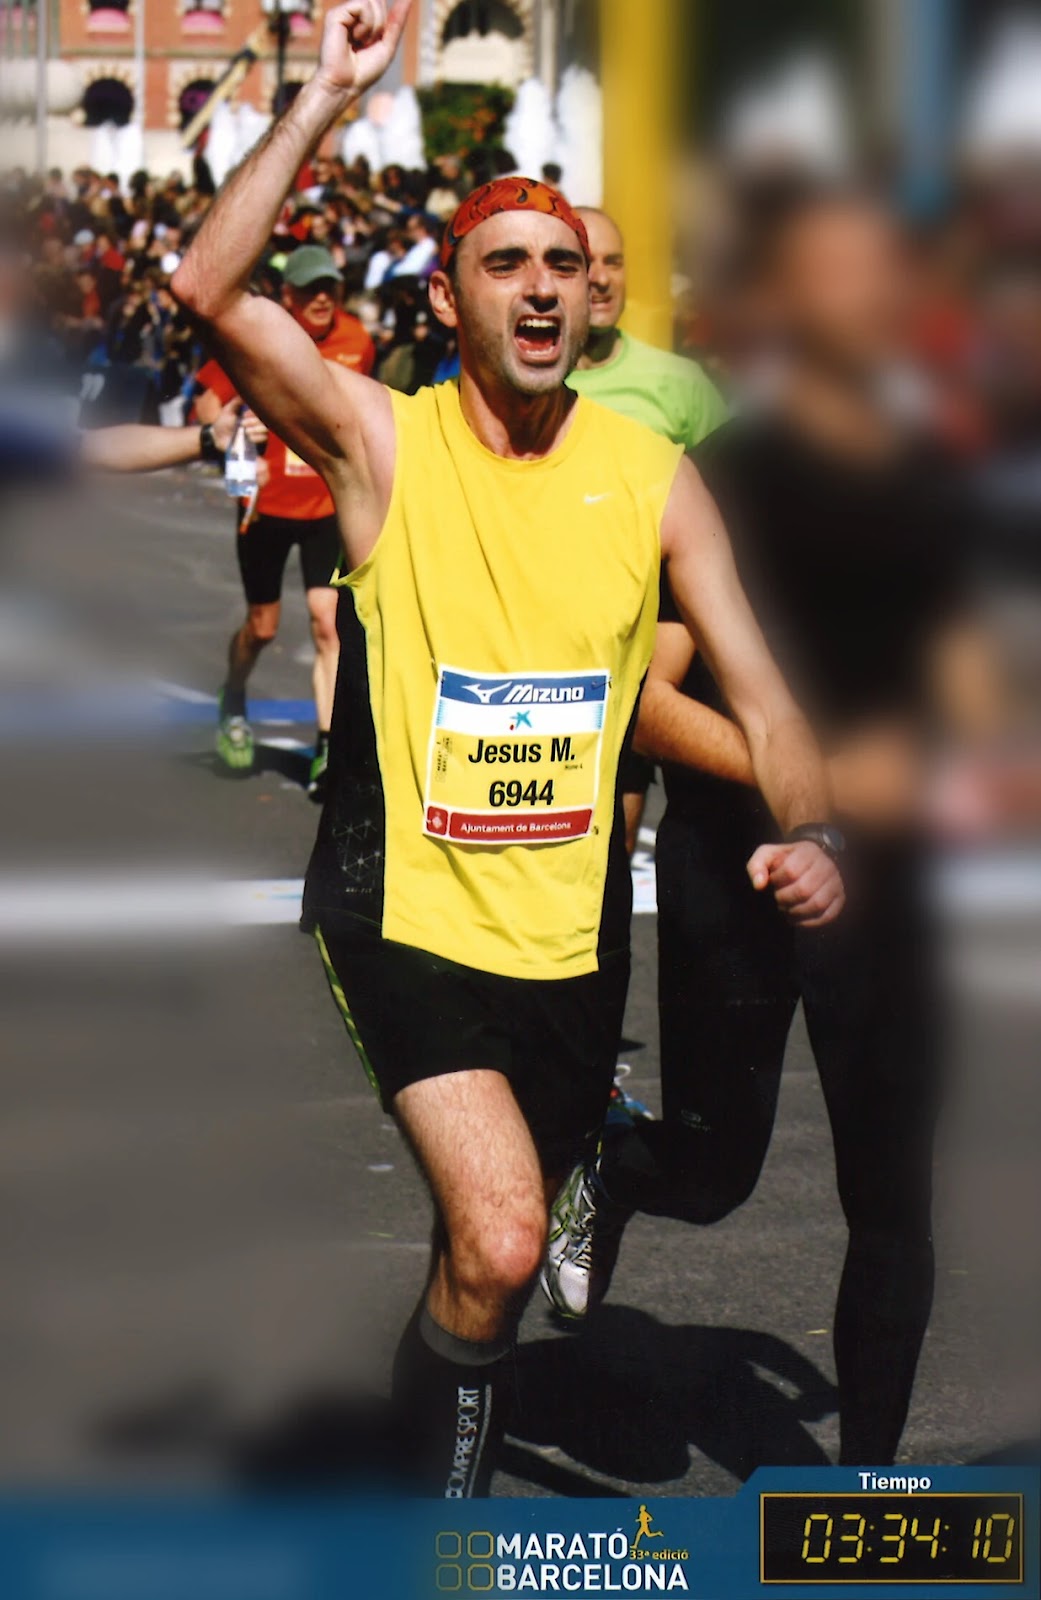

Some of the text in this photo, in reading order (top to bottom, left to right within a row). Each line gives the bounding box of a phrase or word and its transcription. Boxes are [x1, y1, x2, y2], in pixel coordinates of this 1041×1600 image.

[468, 739, 542, 764] Jesus
[550, 737, 576, 762] M.
[489, 779, 554, 807] 6944
[460, 822, 572, 834] Ajuntament de Barcelona
